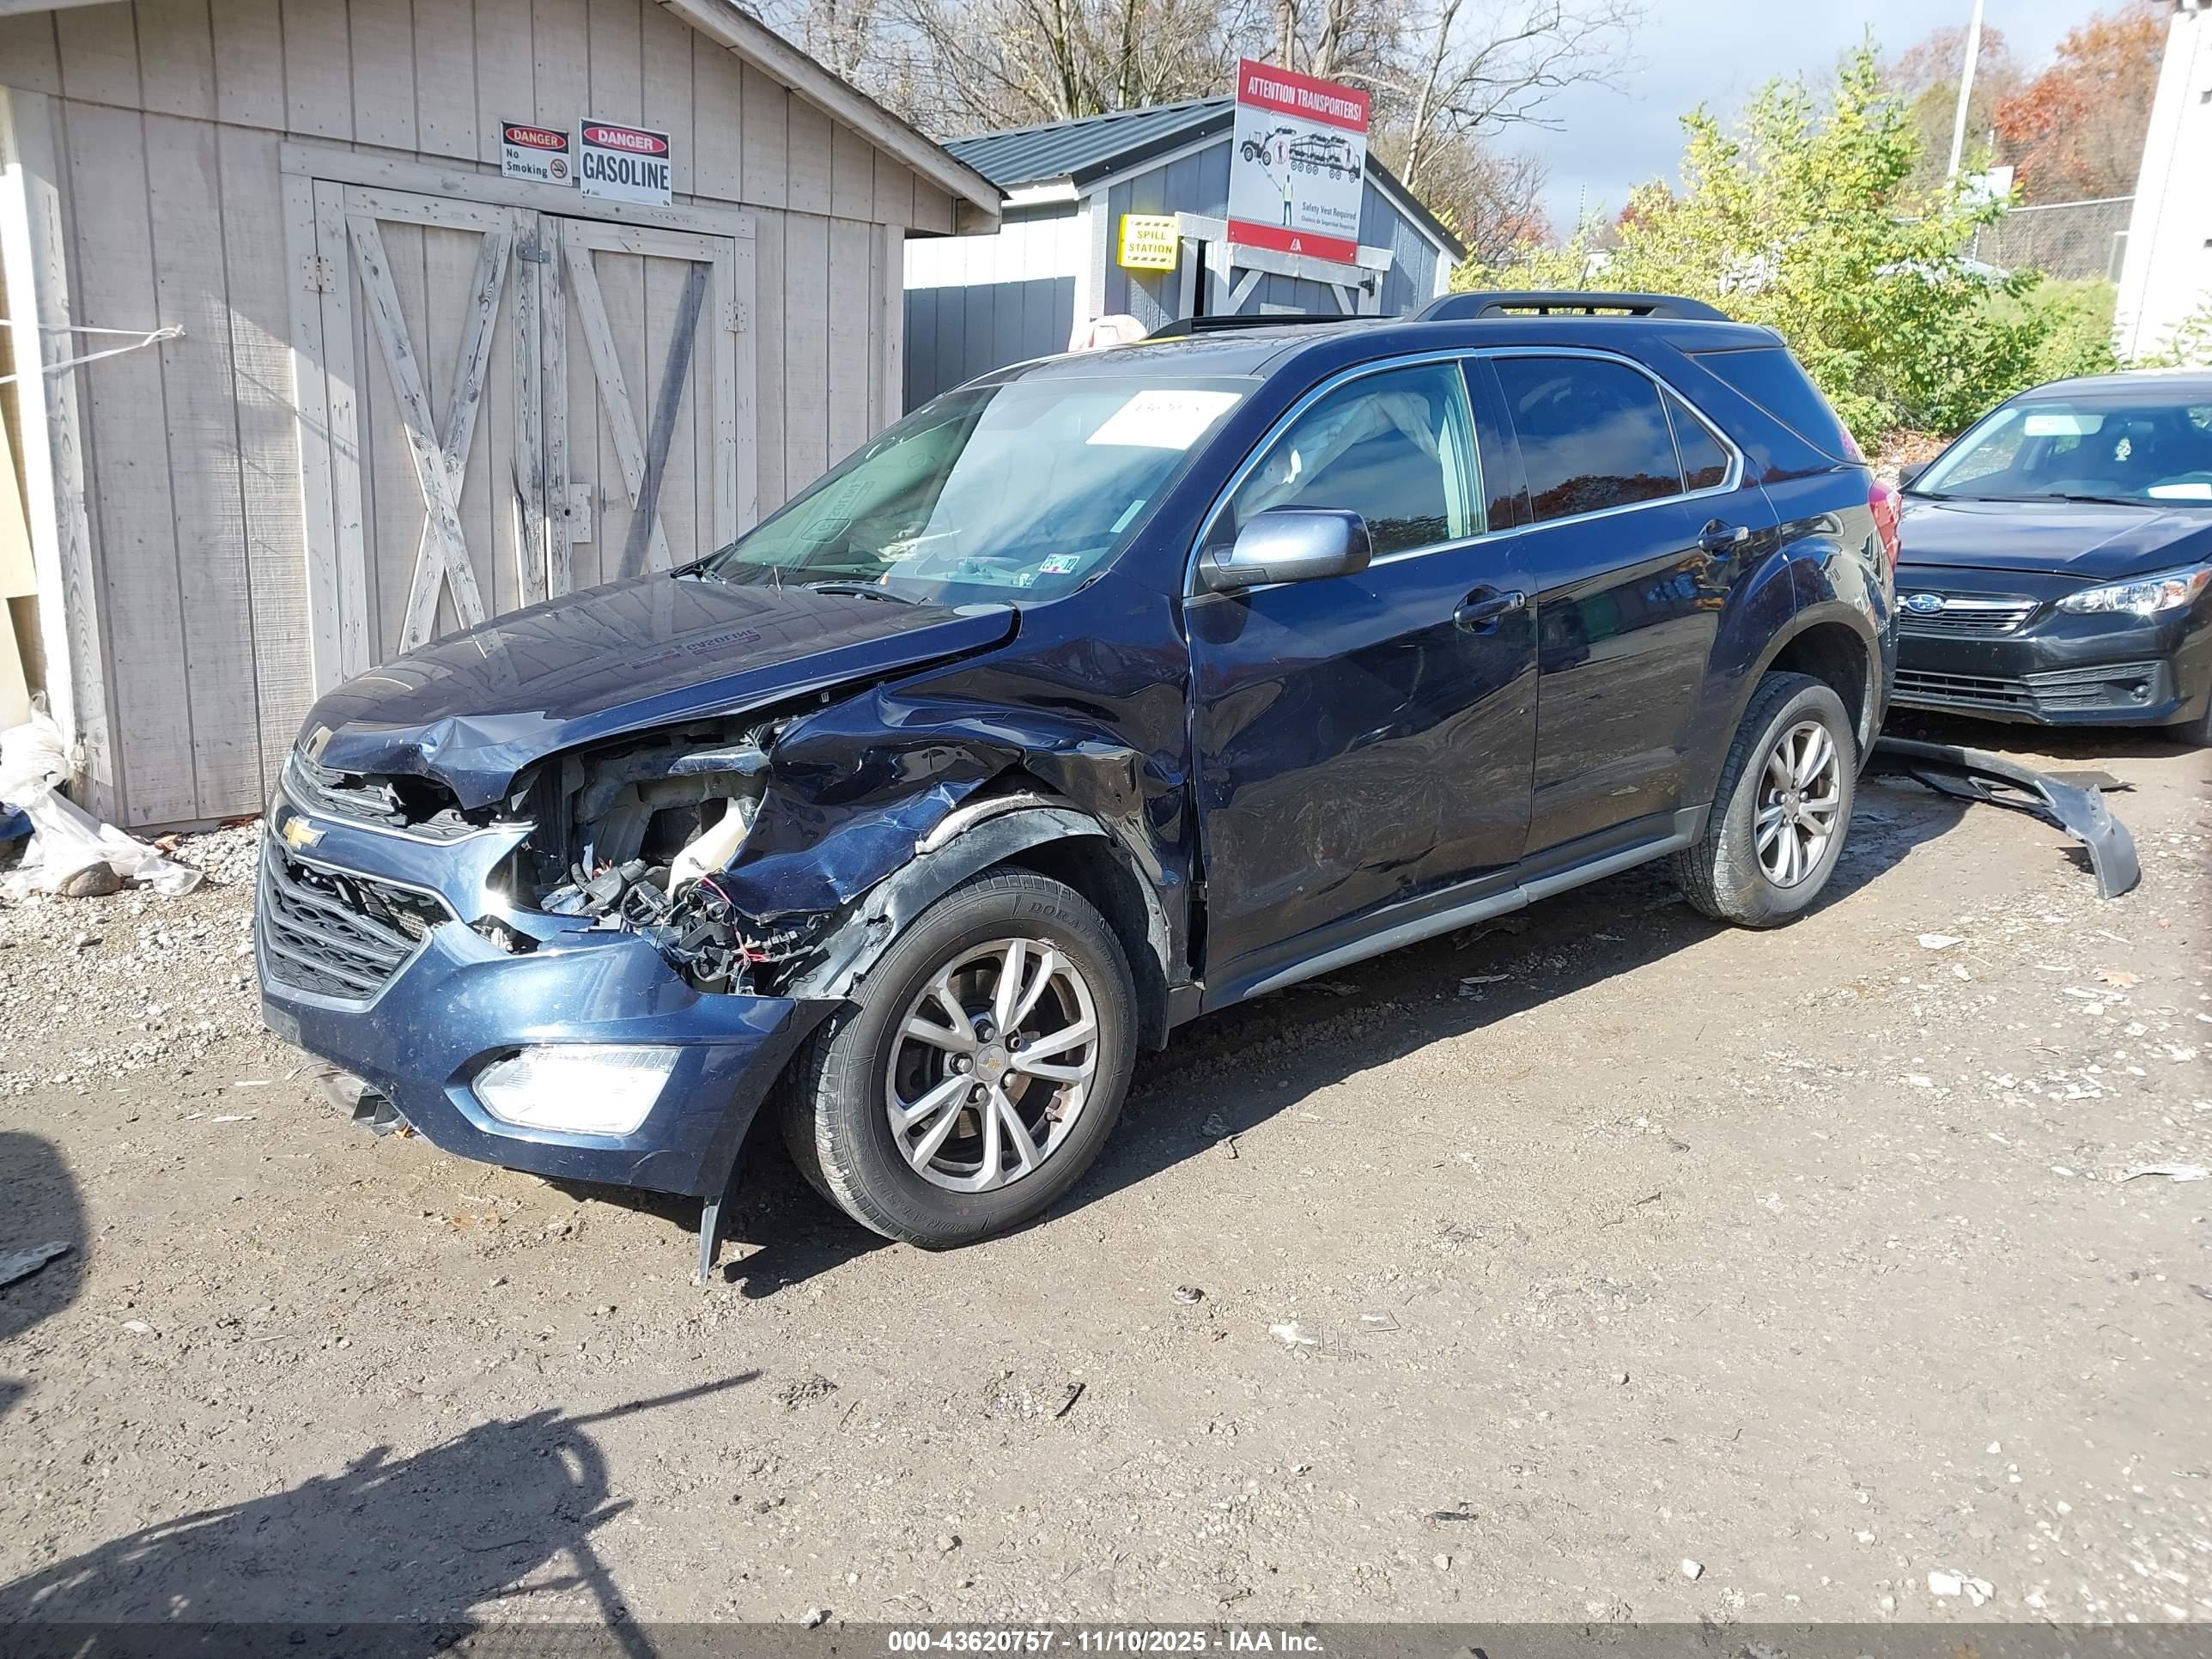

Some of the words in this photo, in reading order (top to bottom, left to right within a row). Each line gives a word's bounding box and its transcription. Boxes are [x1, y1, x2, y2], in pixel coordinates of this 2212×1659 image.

[1248, 76, 1296, 105] ATTENTION
[1297, 88, 1362, 121] TRANSPORTERS!
[514, 130, 558, 147] DANGER
[598, 129, 653, 150] DANGER
[506, 148, 520, 159] No
[507, 161, 548, 179] Smoking
[582, 152, 670, 191] GASOLINE
[1302, 201, 1320, 215] Safety
[1321, 205, 1332, 216] Vest
[1333, 207, 1357, 221] Required
[1137, 230, 1166, 240] SPILL
[1128, 243, 1172, 254] STATION
